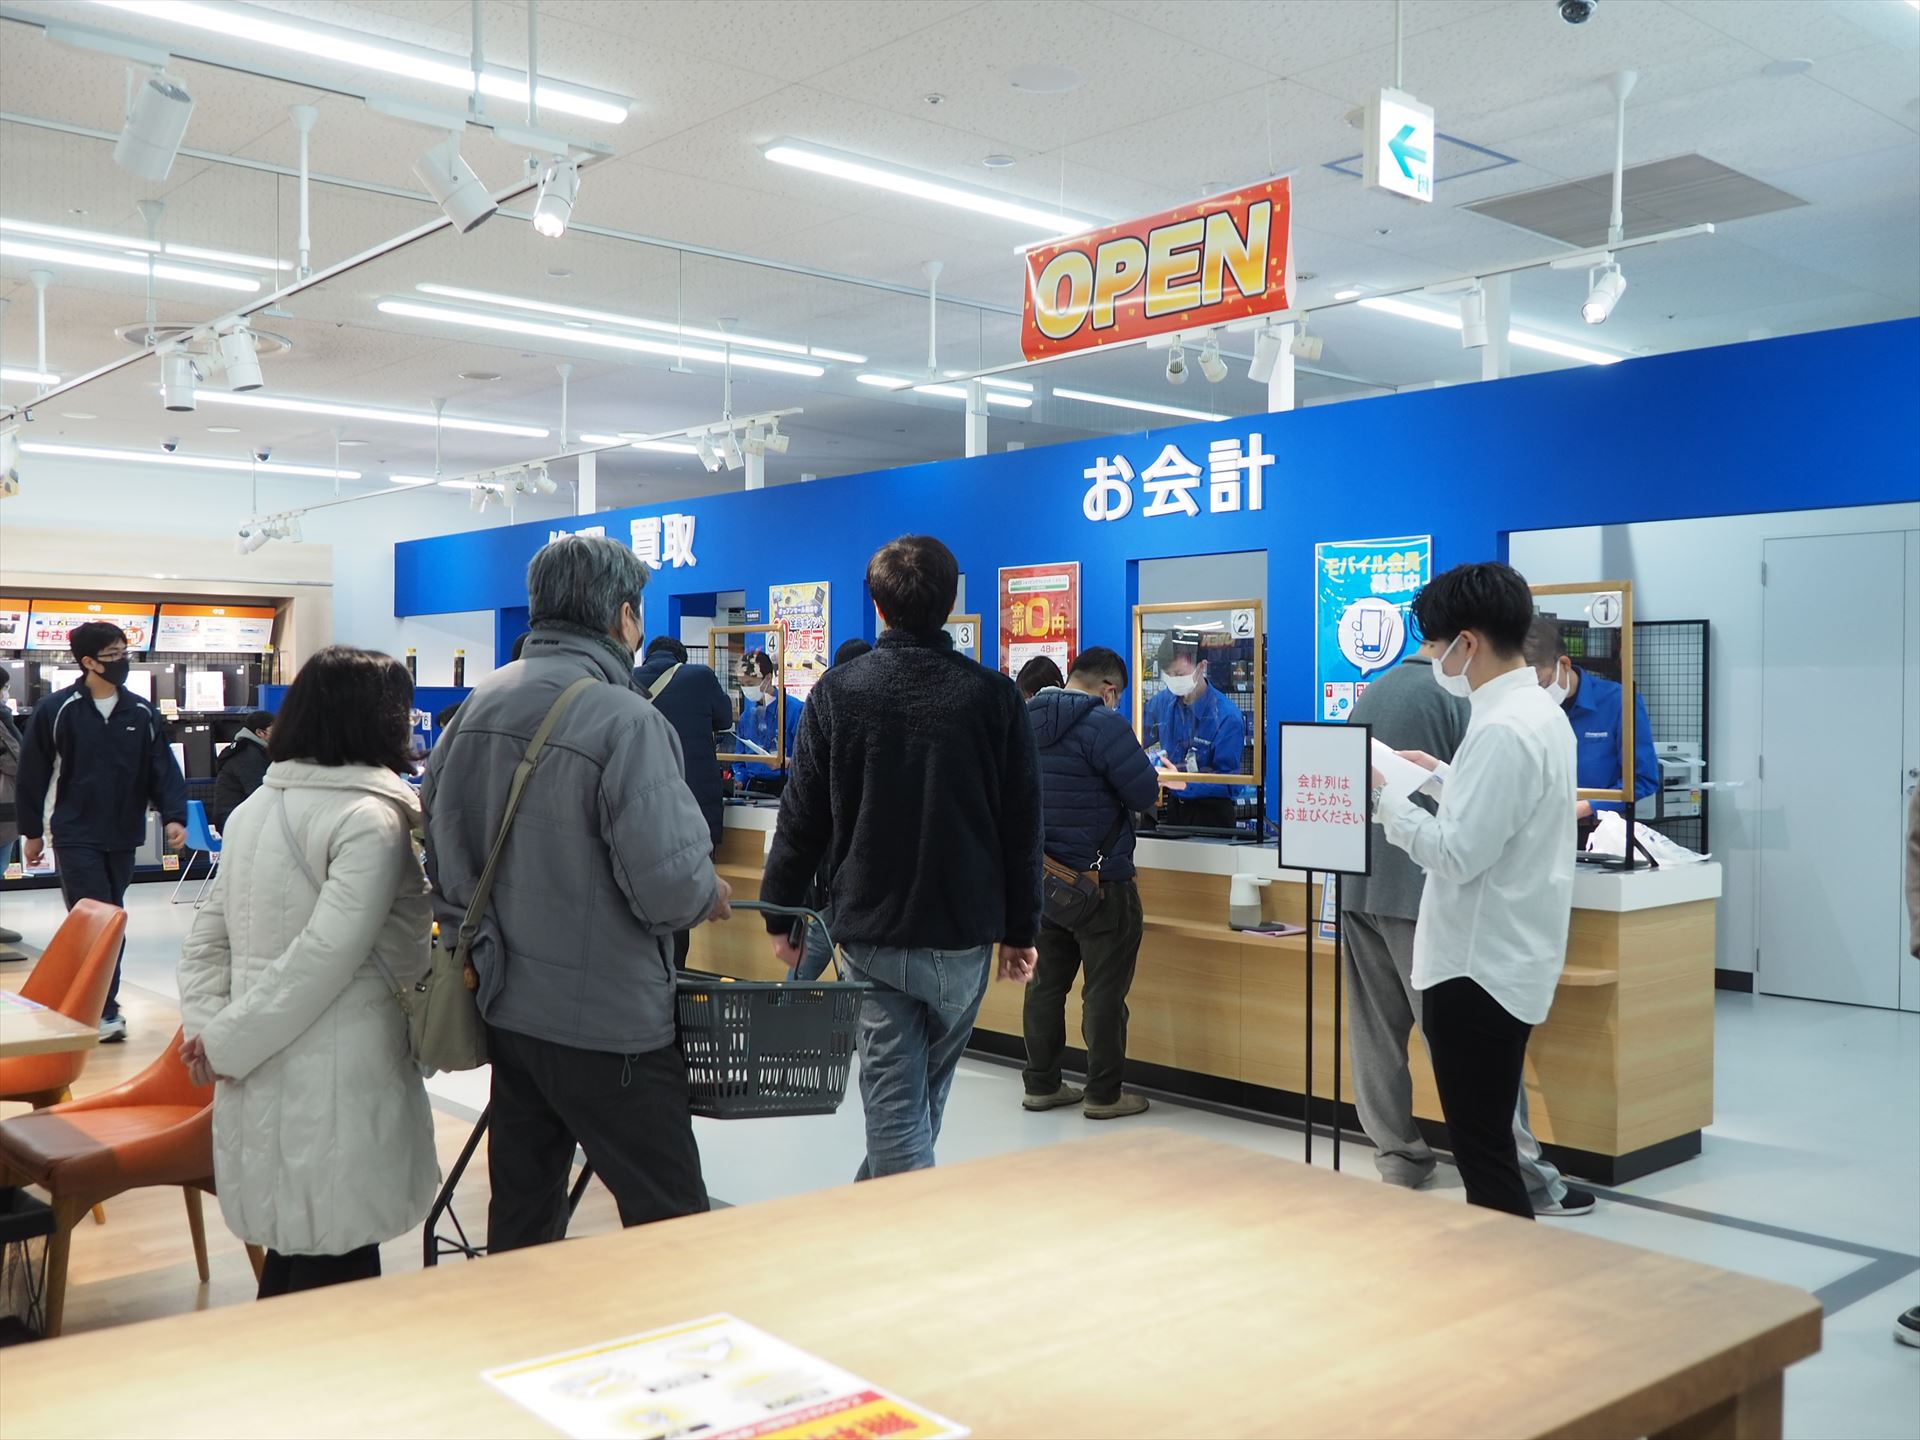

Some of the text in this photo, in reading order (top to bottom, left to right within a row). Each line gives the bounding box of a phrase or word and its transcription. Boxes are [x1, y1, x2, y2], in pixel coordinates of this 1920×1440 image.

[1034, 199, 1272, 340] OPEN
[1083, 433, 1276, 521] お会計
[630, 513, 697, 570] 買取
[1325, 552, 1420, 576] モバイル会員
[1298, 774, 1351, 789] 会計列は
[1296, 791, 1352, 807] こちらから
[1284, 807, 1365, 825] お並びください
